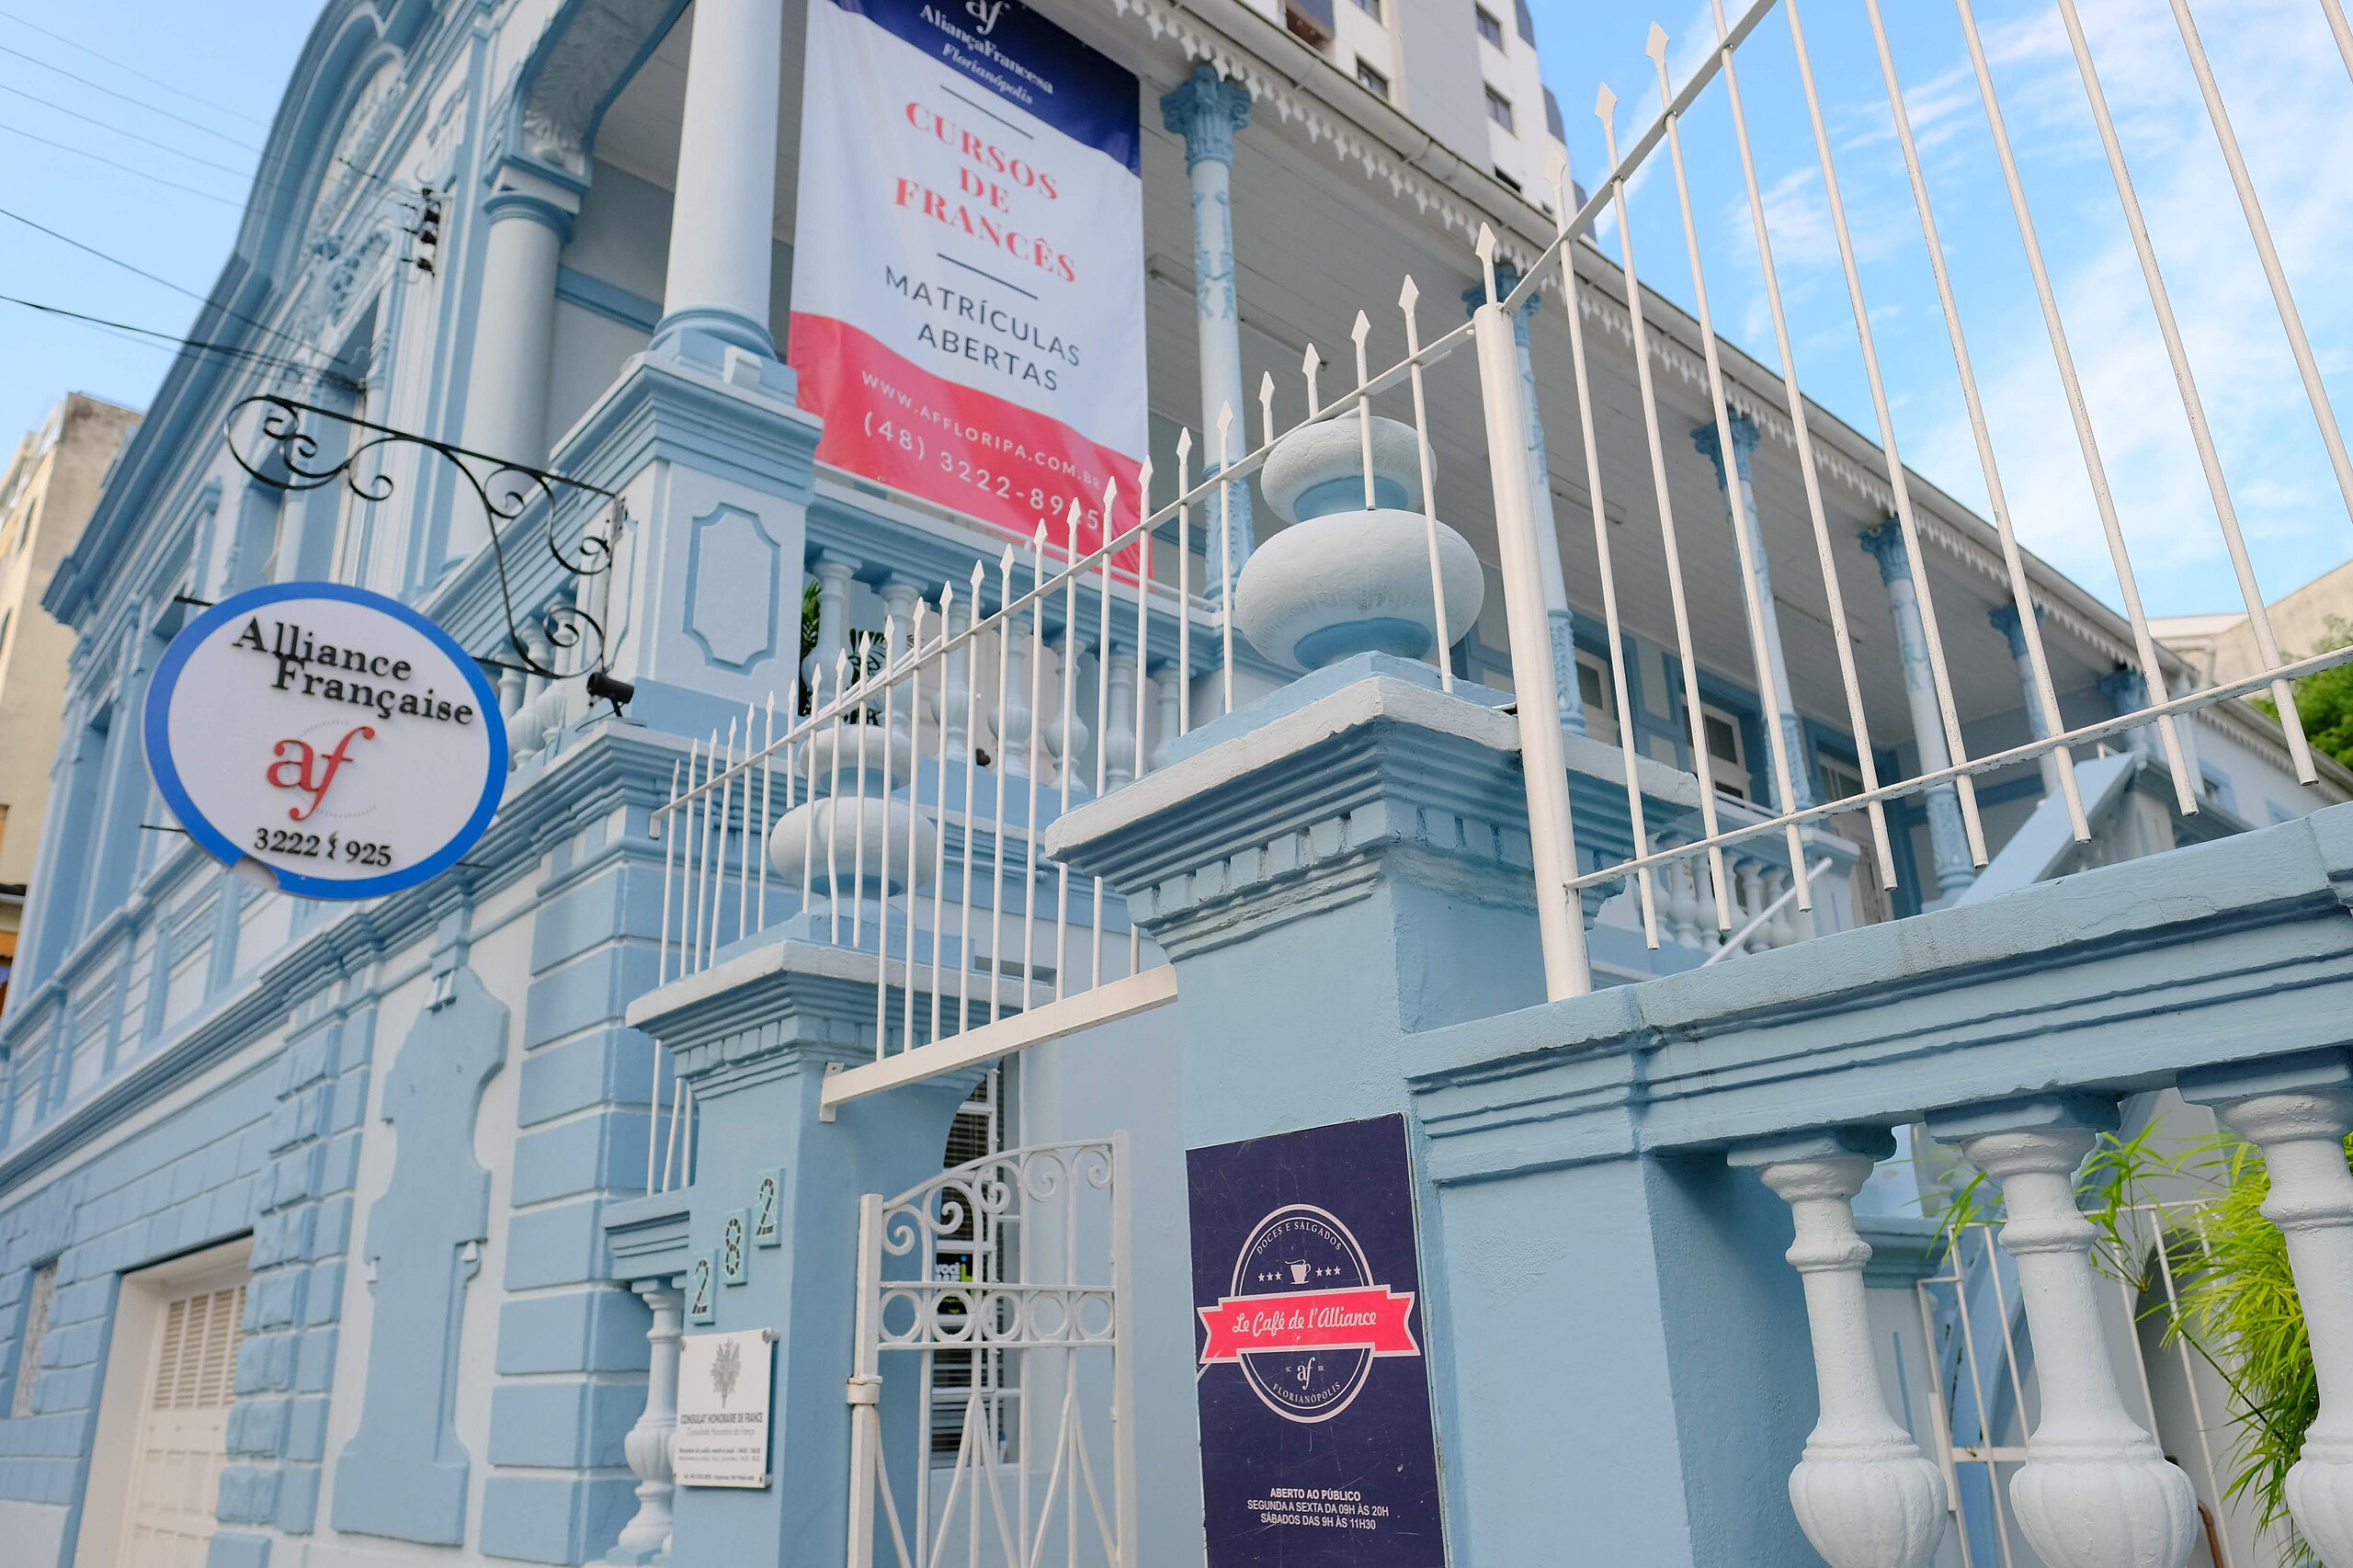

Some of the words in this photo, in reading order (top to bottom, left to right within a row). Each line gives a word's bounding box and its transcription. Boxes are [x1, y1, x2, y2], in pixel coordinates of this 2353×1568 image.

[905, 102, 1058, 201] CURSOS
[959, 166, 1010, 213] DE
[893, 176, 1075, 282] FRANCÊS
[884, 265, 1081, 367] MATRÍCULAS
[917, 323, 1058, 392] ABERTAS
[863, 411, 926, 460] (48)
[940, 451, 1100, 531] 3222-895
[232, 616, 412, 681] Alliance
[271, 653, 473, 724] Française
[266, 725, 375, 821] af
[254, 827, 320, 858] 3222
[1256, 1226, 1283, 1255] DOCES
[1285, 1222, 1291, 1232] E
[1294, 1221, 1342, 1251] SALGADOS
[1232, 1312, 1250, 1333] Le
[1253, 1311, 1285, 1337] Café
[1288, 1309, 1304, 1330] de
[1307, 1306, 1377, 1329] l'Alliance
[1272, 1381, 1341, 1404] FLORIANÓPOLIS
[1297, 1357, 1316, 1390] af
[1246, 1499, 1287, 1511] SEGUNDA
[1288, 1502, 1295, 1511] A
[1296, 1502, 1324, 1513] SEXTA
[1324, 1503, 1337, 1514] DA
[1338, 1504, 1356, 1515] 09H
[1358, 1503, 1370, 1516] ÀS
[1371, 1506, 1389, 1517] 20H
[1270, 1487, 1305, 1499] ABERTO
[1306, 1489, 1320, 1500] AO
[1322, 1488, 1361, 1502] PÚBLICO
[1260, 1512, 1301, 1525] SÁBADOS
[1302, 1516, 1320, 1527] DAS
[1322, 1517, 1334, 1528] 9H
[1336, 1516, 1347, 1528] ÀS
[1349, 1518, 1377, 1529] 11H30
